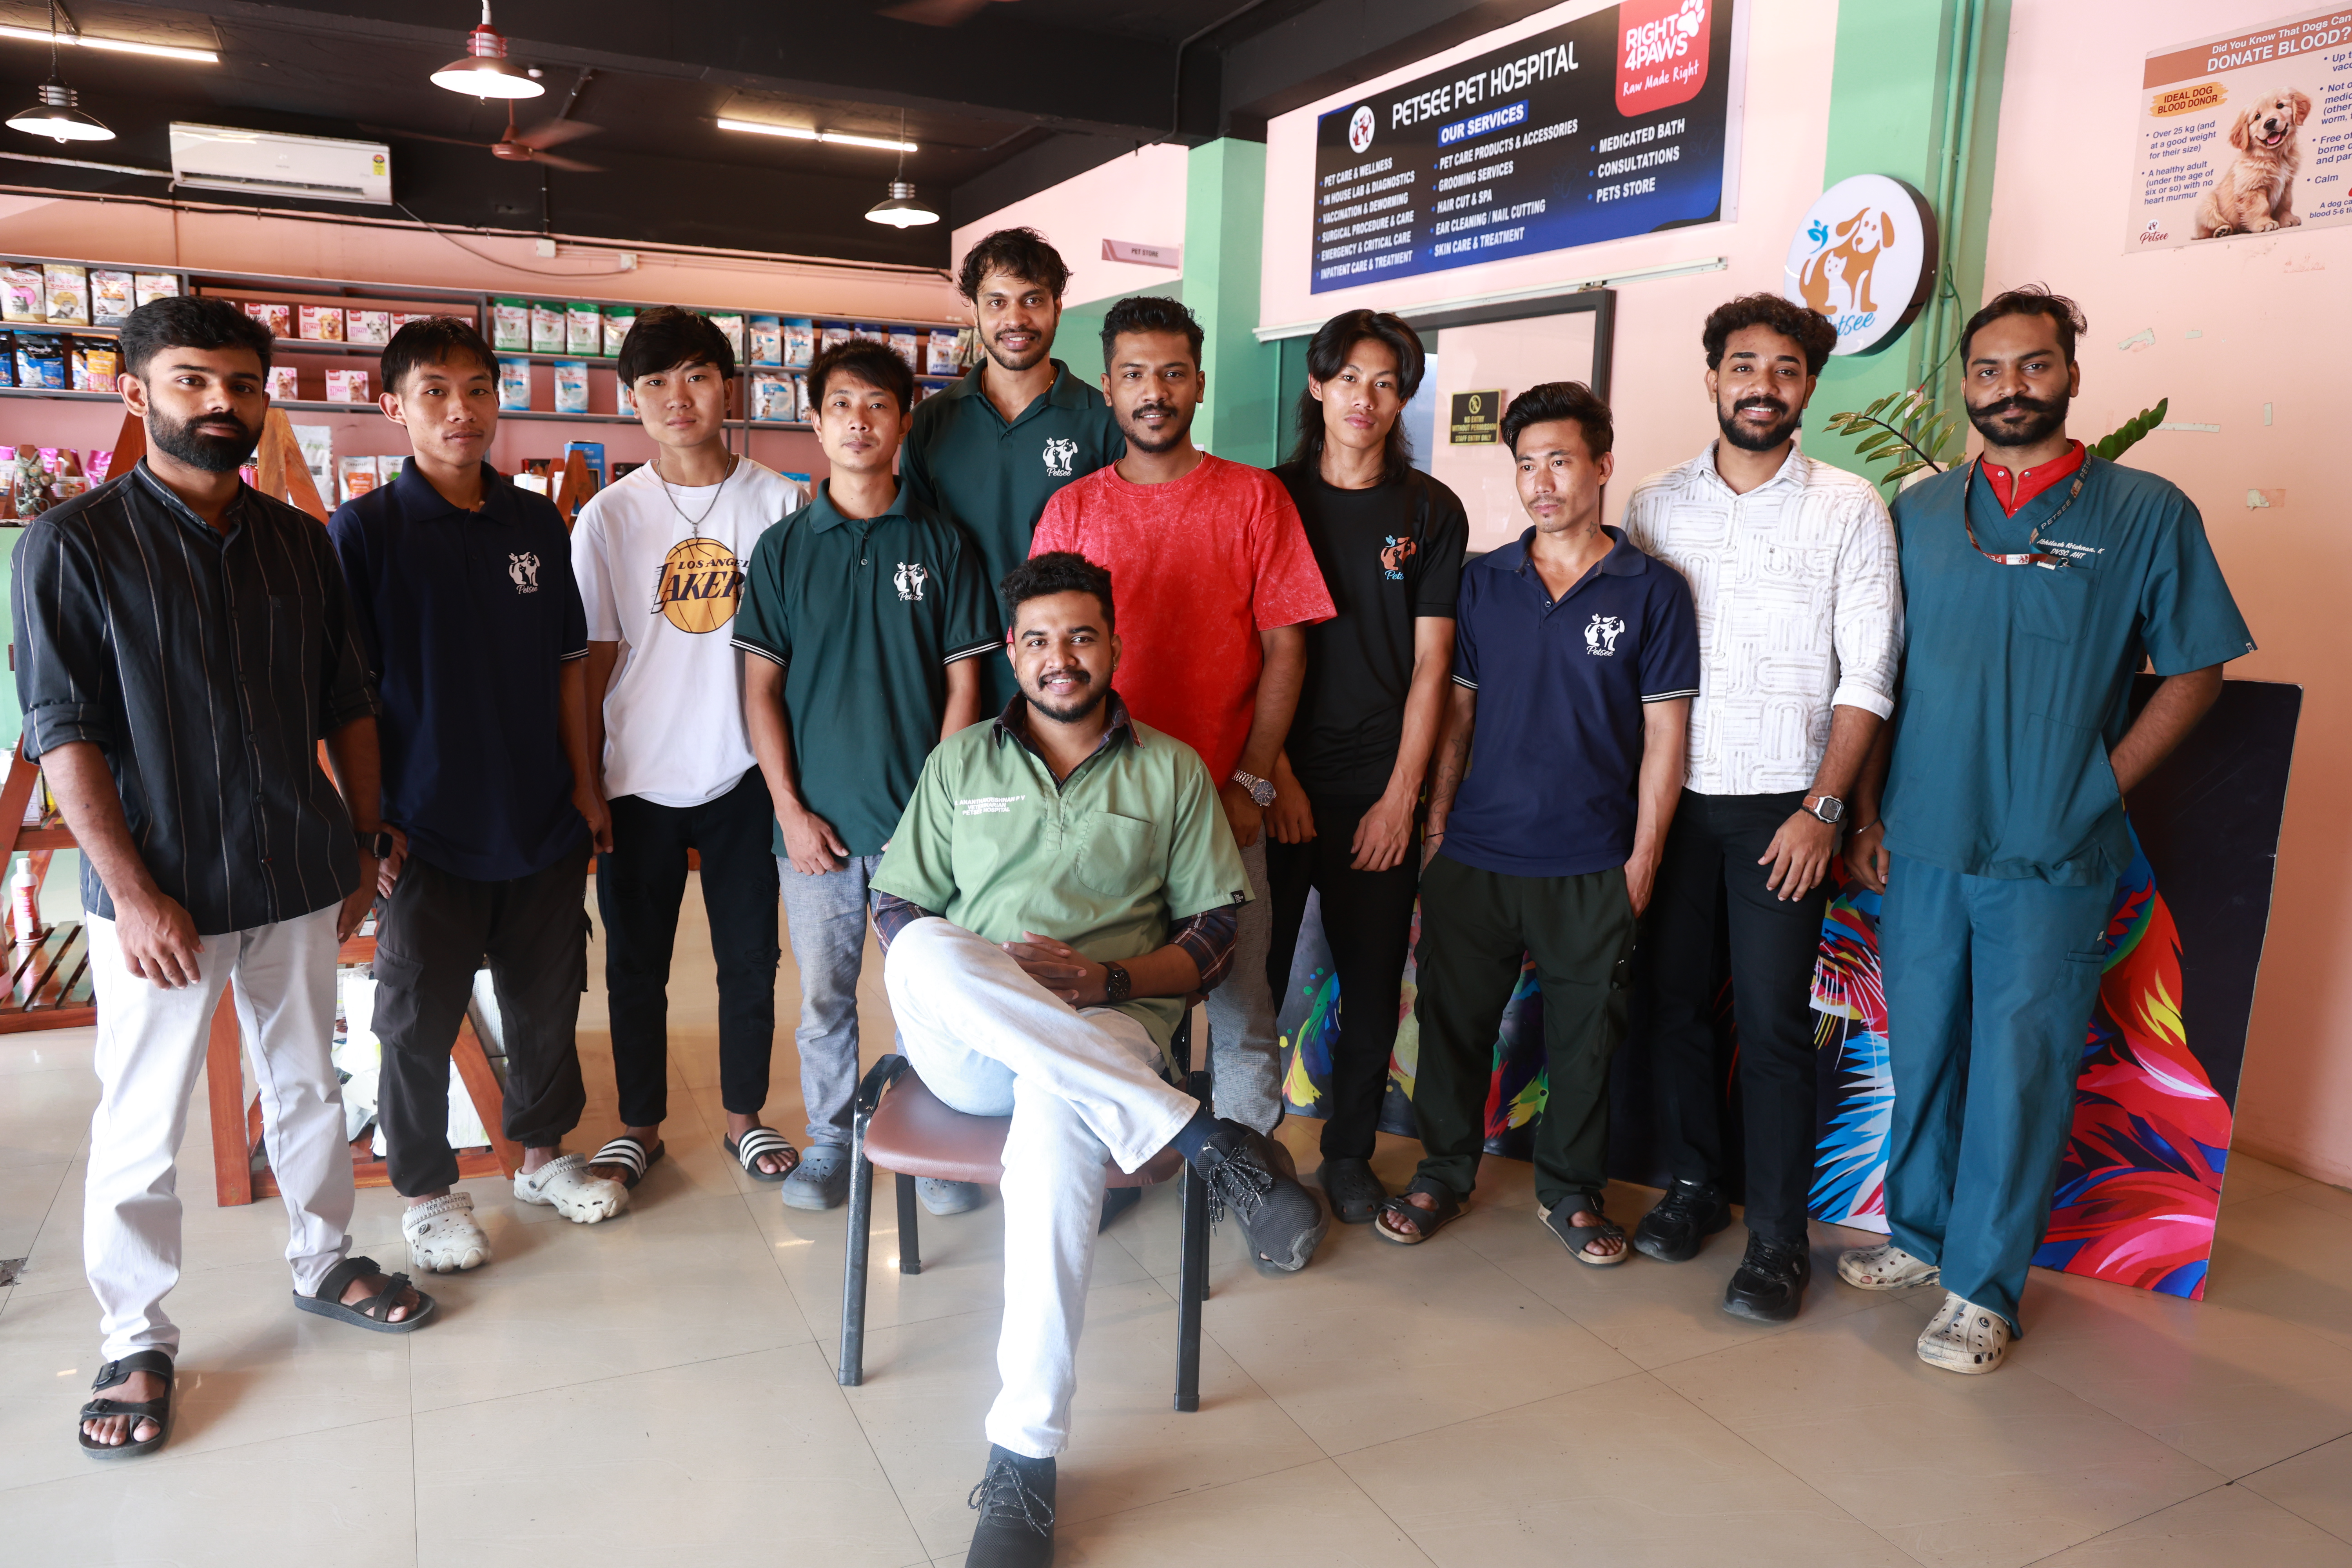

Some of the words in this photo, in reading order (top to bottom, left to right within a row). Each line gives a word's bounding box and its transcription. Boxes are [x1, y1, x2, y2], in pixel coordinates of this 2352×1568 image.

[1626, 13, 1679, 51] RIGHT
[2212, 43, 2227, 54] Did
[2230, 40, 2247, 49] You
[2249, 33, 2276, 45] Know
[2278, 27, 2299, 38] That
[2302, 20, 2328, 31] Dogs
[2331, 15, 2351, 25] Can
[1624, 32, 1688, 71] 4PAWS
[2207, 44, 2273, 72] DONATE
[2278, 26, 2351, 56] BLOOD?
[2332, 53, 2345, 63] Up
[1392, 85, 1450, 130] PETSEE
[1455, 72, 1487, 109] PET
[1490, 41, 1579, 97] HOSPITAL
[1623, 82, 1642, 97] Raw
[1644, 69, 1670, 90] Made
[1673, 59, 1699, 85] Right
[2328, 82, 2345, 92] Not
[2158, 101, 2186, 114] BLOOD
[2188, 94, 2218, 108] DONOR
[2164, 91, 2190, 103] IDEAL
[2193, 86, 2212, 98] DOG
[2323, 103, 2352, 116] (other
[1441, 123, 1465, 143] OUR
[1467, 104, 1524, 135] SERVICES
[2321, 114, 2348, 125] worm,
[1599, 126, 1655, 154] MEDICATED
[1657, 118, 1685, 139] BATH
[2153, 130, 2171, 139] Over
[2173, 127, 2183, 135] 25
[2197, 120, 2215, 132] (and
[1439, 155, 1453, 170] PET
[1454, 149, 1473, 166] CARE
[1474, 138, 1514, 161] PRODUCTS
[1515, 135, 1521, 149] &
[1523, 118, 1578, 147] ACCESSORIES
[2167, 136, 2187, 148] good
[2189, 131, 2216, 142] weight
[2318, 144, 2345, 154] borne
[2320, 135, 2341, 144] Free
[2162, 148, 2180, 157] their
[2182, 144, 2201, 154] size)
[2316, 155, 2334, 165] and
[1598, 145, 1680, 178] CONSULTATIONS
[2156, 165, 2185, 176] healthy
[2187, 161, 2207, 171] adult
[1324, 174, 1336, 188] PET
[1336, 169, 1353, 184] CARE
[1353, 167, 1358, 179] &
[1359, 157, 1393, 178] WELLNESS
[1439, 171, 1476, 192] GROOMING
[1477, 160, 1514, 182] SERVICES
[2146, 177, 2171, 188] (under
[2188, 172, 2203, 181] age
[2315, 174, 2338, 184] Calm
[1323, 194, 1330, 206] IN
[1331, 188, 1352, 204] HOUSE
[1352, 184, 1365, 199] LAB
[1365, 183, 1370, 195] &
[1372, 170, 1415, 193] DIAGNOSTICS
[1596, 184, 1621, 203] PETS
[1622, 176, 1656, 198] STORE
[2169, 184, 2181, 192] so)
[2183, 181, 2200, 190] with
[1437, 198, 1454, 214] HAIR
[1455, 194, 1470, 210] CUT
[1471, 192, 1477, 206] &
[1478, 189, 1492, 204] SPA
[2144, 196, 2164, 205] heart
[2166, 191, 2198, 202] murmur
[1323, 204, 1362, 225] VACCINATION
[1363, 203, 1368, 214] &
[1369, 192, 1408, 213] DEWORMING
[1436, 221, 1450, 236] EAR
[1451, 212, 1487, 232] CLEANING
[1492, 207, 1509, 223] NAIL
[1511, 199, 1546, 219] CUTTING
[2309, 210, 2331, 218] blood
[1322, 226, 1351, 243] SURGICAL
[1352, 216, 1389, 236] PROCEDURE
[1390, 215, 1395, 227] &
[1396, 210, 1414, 226] CARE
[1321, 243, 1357, 262] EMERGENCY
[1357, 241, 1363, 254] &
[1363, 235, 1392, 252] CRITICAL
[1393, 230, 1412, 246] CARE
[1434, 241, 1451, 257] SKIN
[1452, 238, 1472, 254] CARE
[1472, 236, 1478, 250] &
[1480, 227, 1525, 247] TREATMENT
[2140, 231, 2169, 244] Petsee
[1321, 263, 1350, 280] INPATIENT
[1351, 260, 1368, 274] CARE
[1368, 258, 1374, 270] &
[1374, 250, 1413, 269] TREATMENT
[1825, 312, 1875, 336] tsee
[1047, 467, 1071, 477] Petsee
[2041, 499, 2072, 530] PETSEE
[2037, 538, 2065, 547] Abhilash
[677, 560, 704, 569] LOS
[706, 558, 749, 568] ANGEL
[516, 584, 538, 594] Petsee
[898, 592, 922, 601] Petsee
[1586, 646, 1613, 656] Petsee
[960, 797, 1015, 805] ANANTHAKRISHNAN
